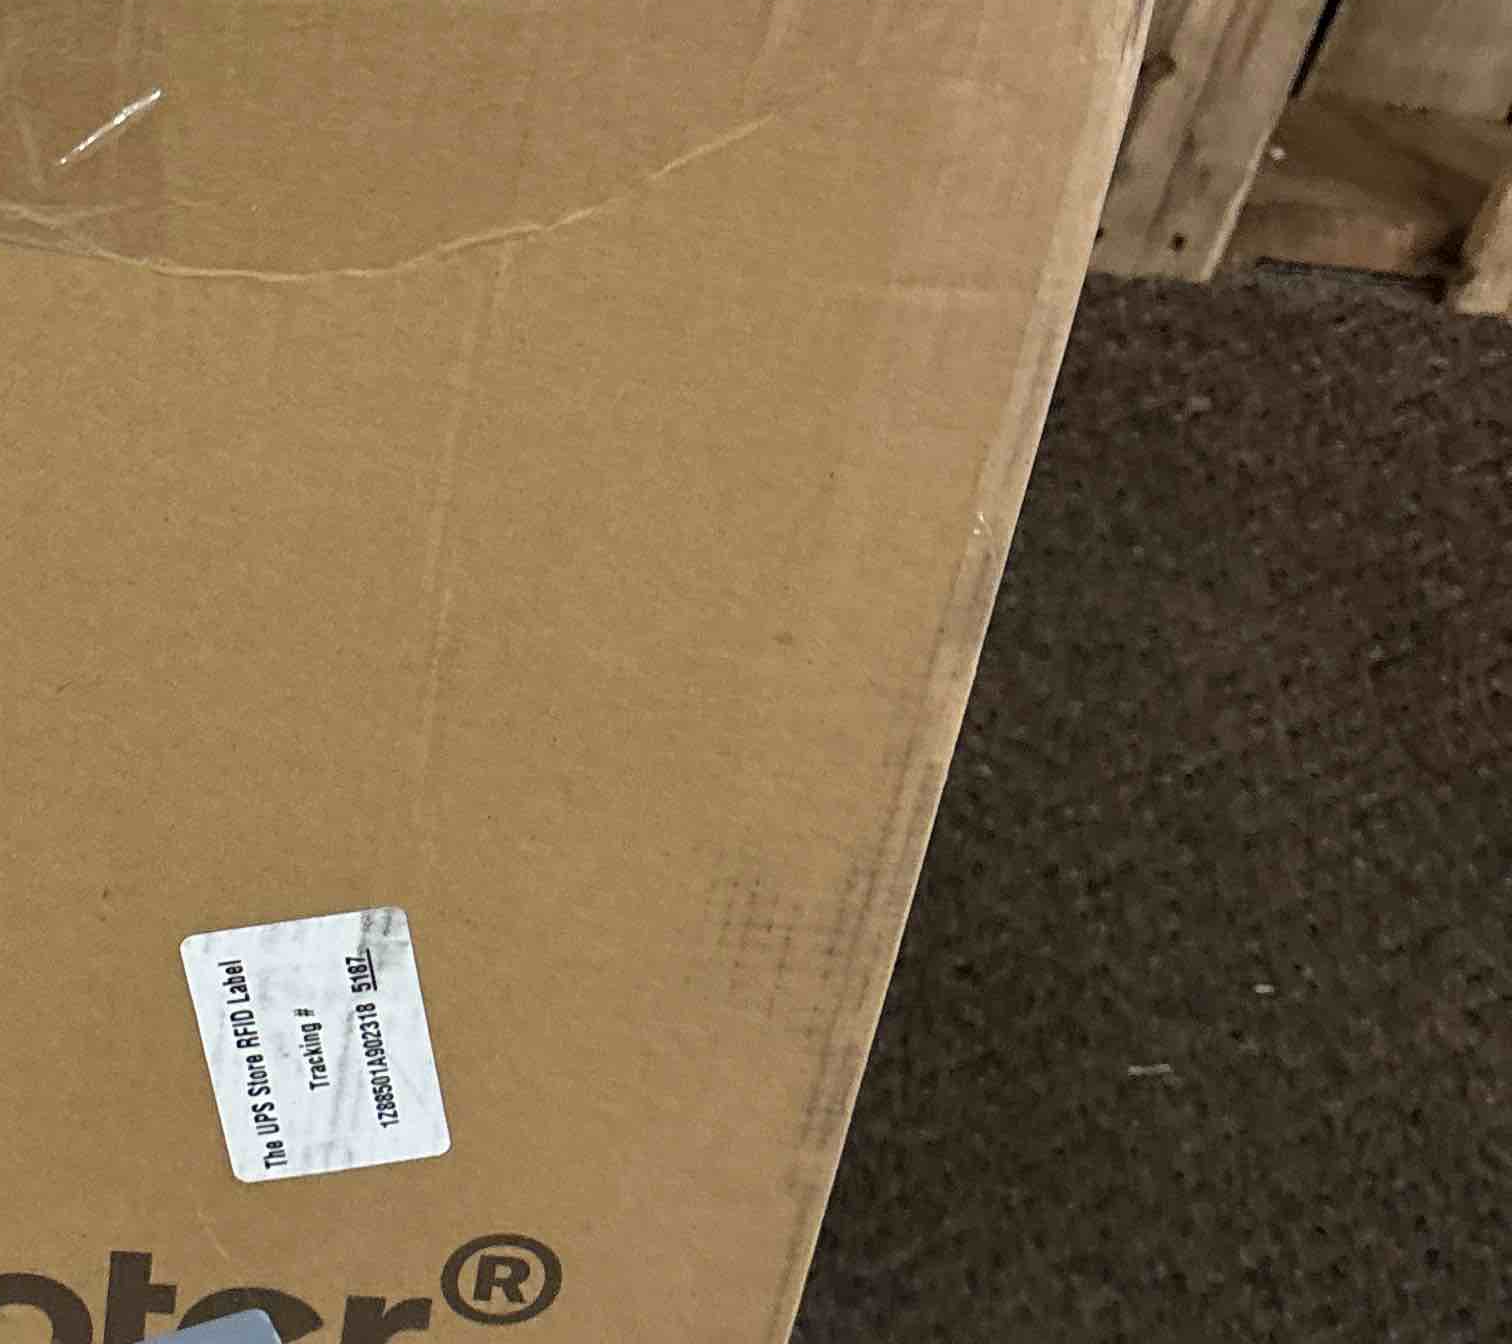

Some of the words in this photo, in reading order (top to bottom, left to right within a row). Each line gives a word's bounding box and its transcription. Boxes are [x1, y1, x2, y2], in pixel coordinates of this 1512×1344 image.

[218, 959, 250, 1005] Label
[345, 955, 372, 994] 5187
[230, 1010, 260, 1049] RFID
[294, 1007, 316, 1018] #
[246, 1053, 271, 1098] Store
[299, 1022, 330, 1091] Tracking
[252, 1101, 280, 1136] UPS
[264, 1139, 288, 1170] The
